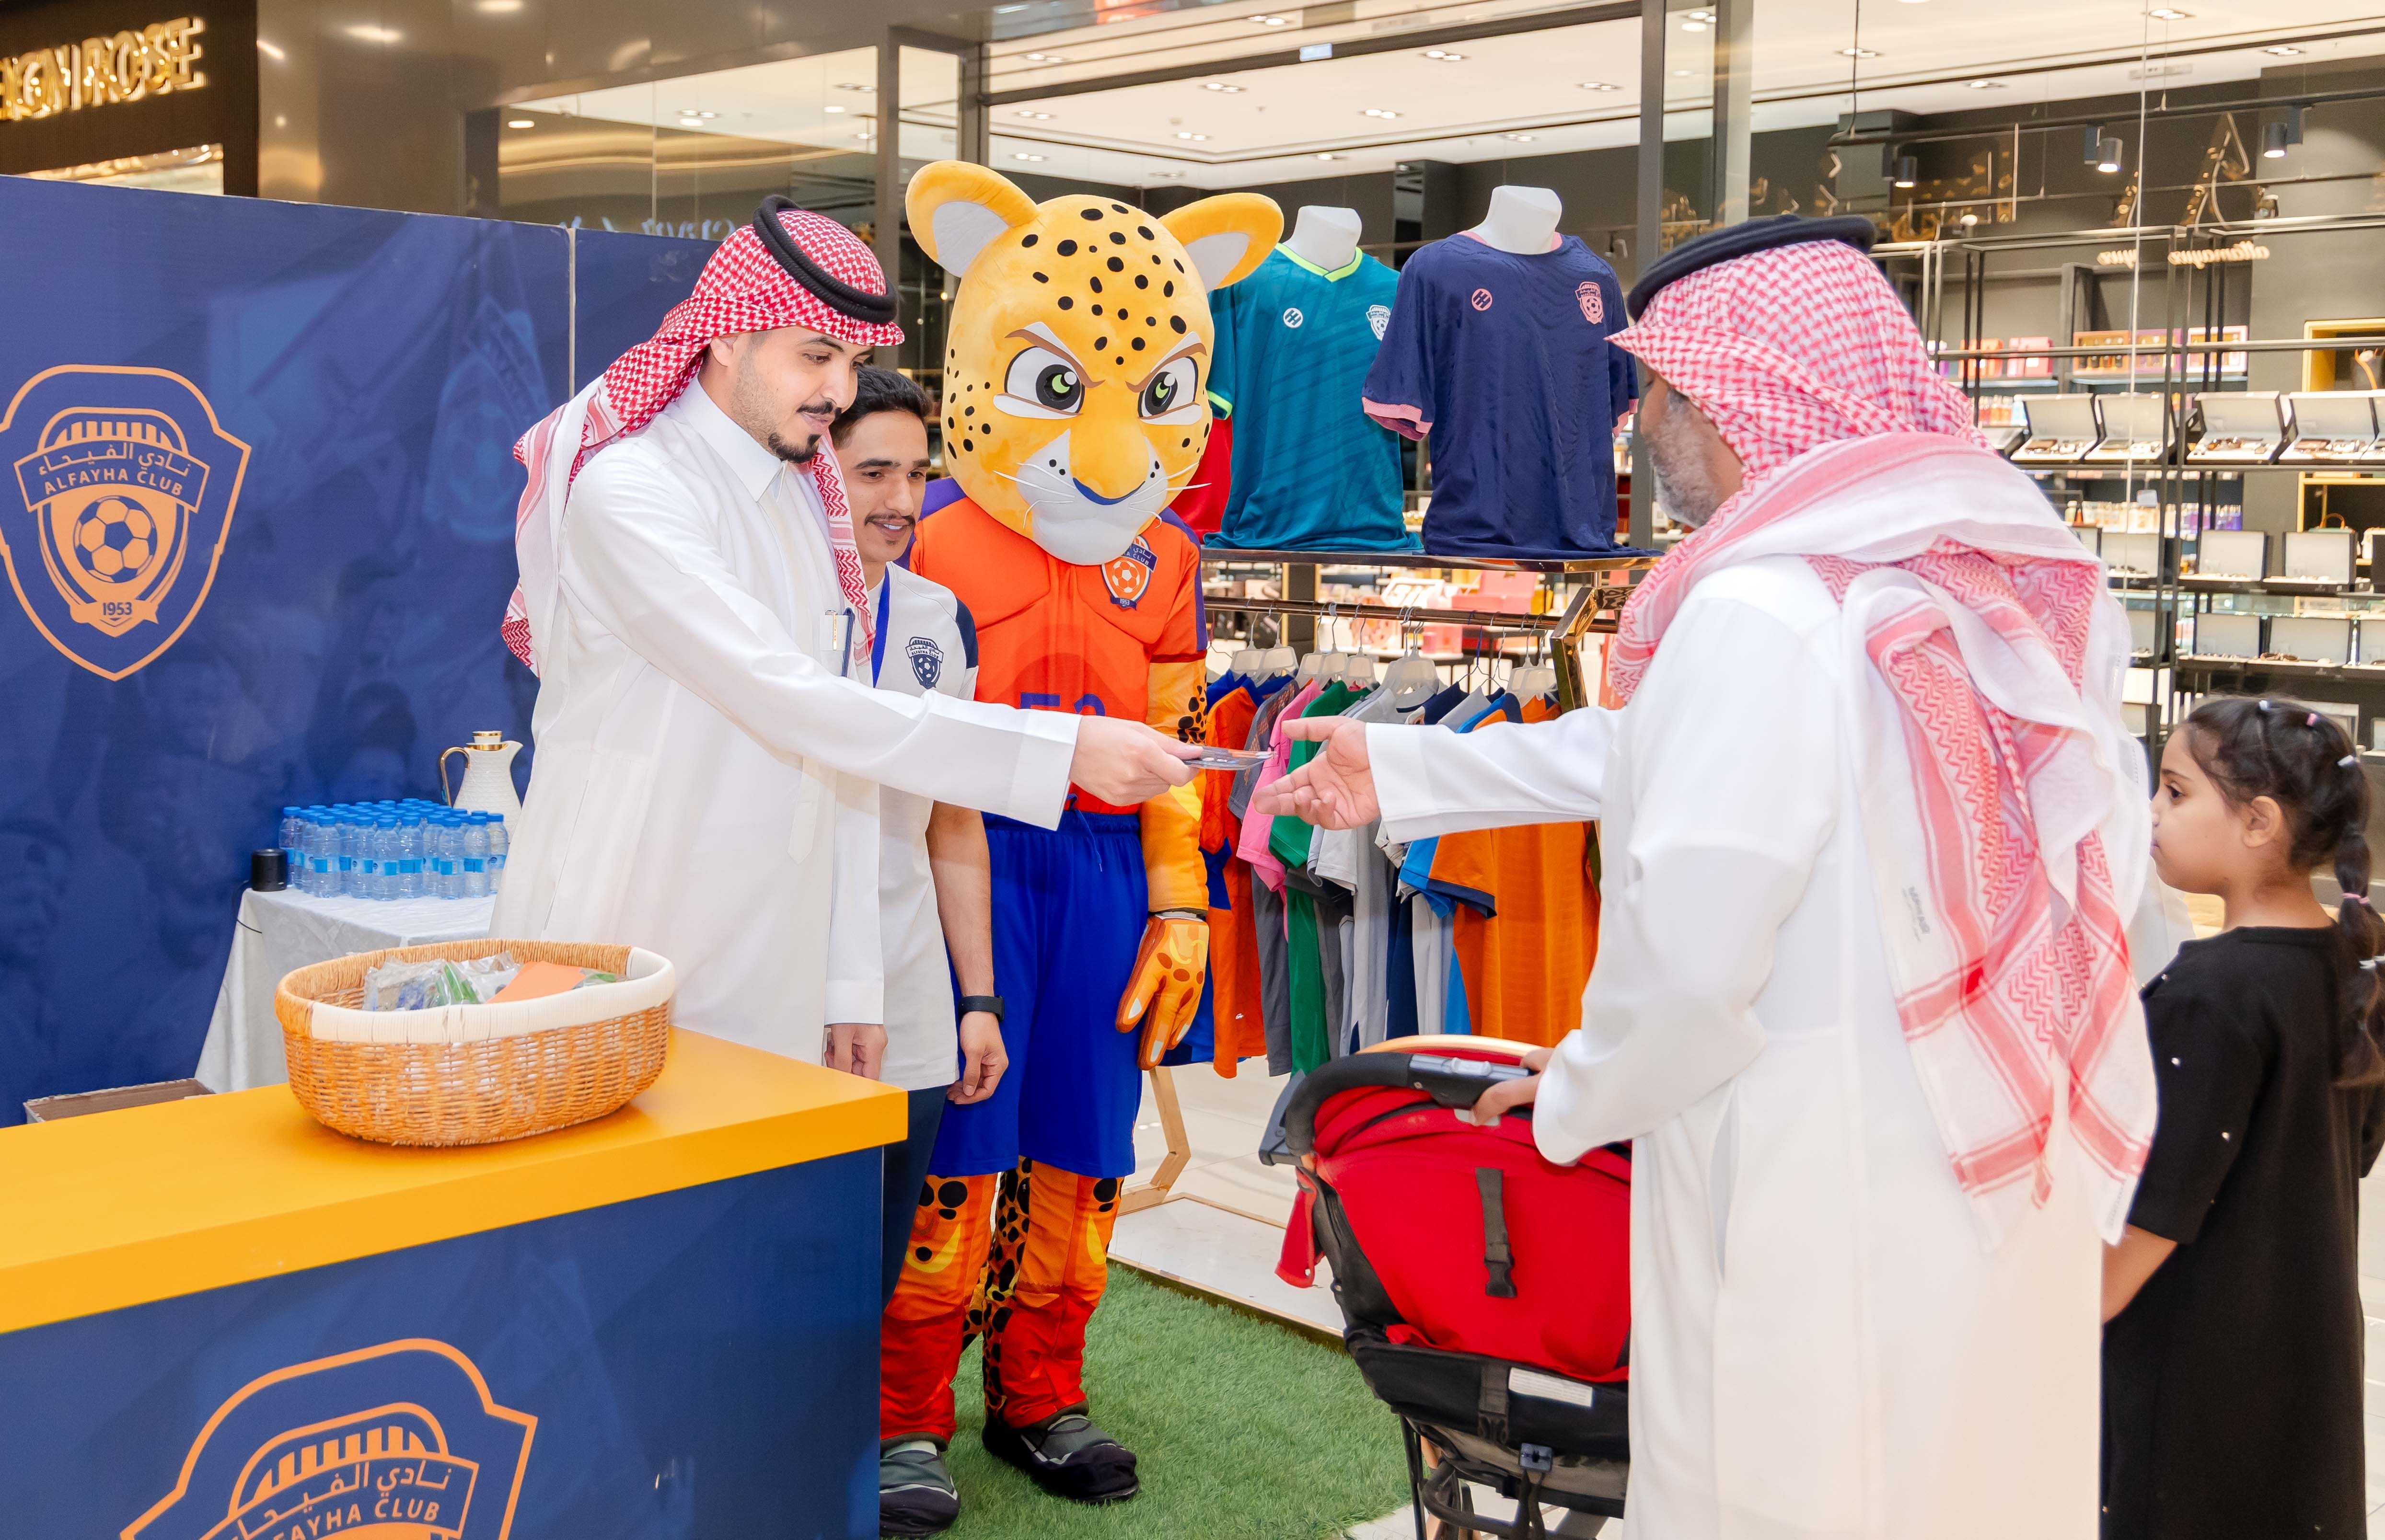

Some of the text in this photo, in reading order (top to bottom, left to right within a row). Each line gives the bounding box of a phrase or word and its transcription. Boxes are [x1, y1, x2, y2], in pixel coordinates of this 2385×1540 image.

[81, 17, 206, 106] ROSE
[39, 443, 191, 478] نادي الفيحاء
[45, 468, 182, 495] ALFAYHA CLUB
[1133, 553, 1149, 566] CLUB
[103, 602, 132, 616] 1953
[231, 1460, 452, 1540] نادي الفيحا
[375, 1498, 440, 1521] CLUB
